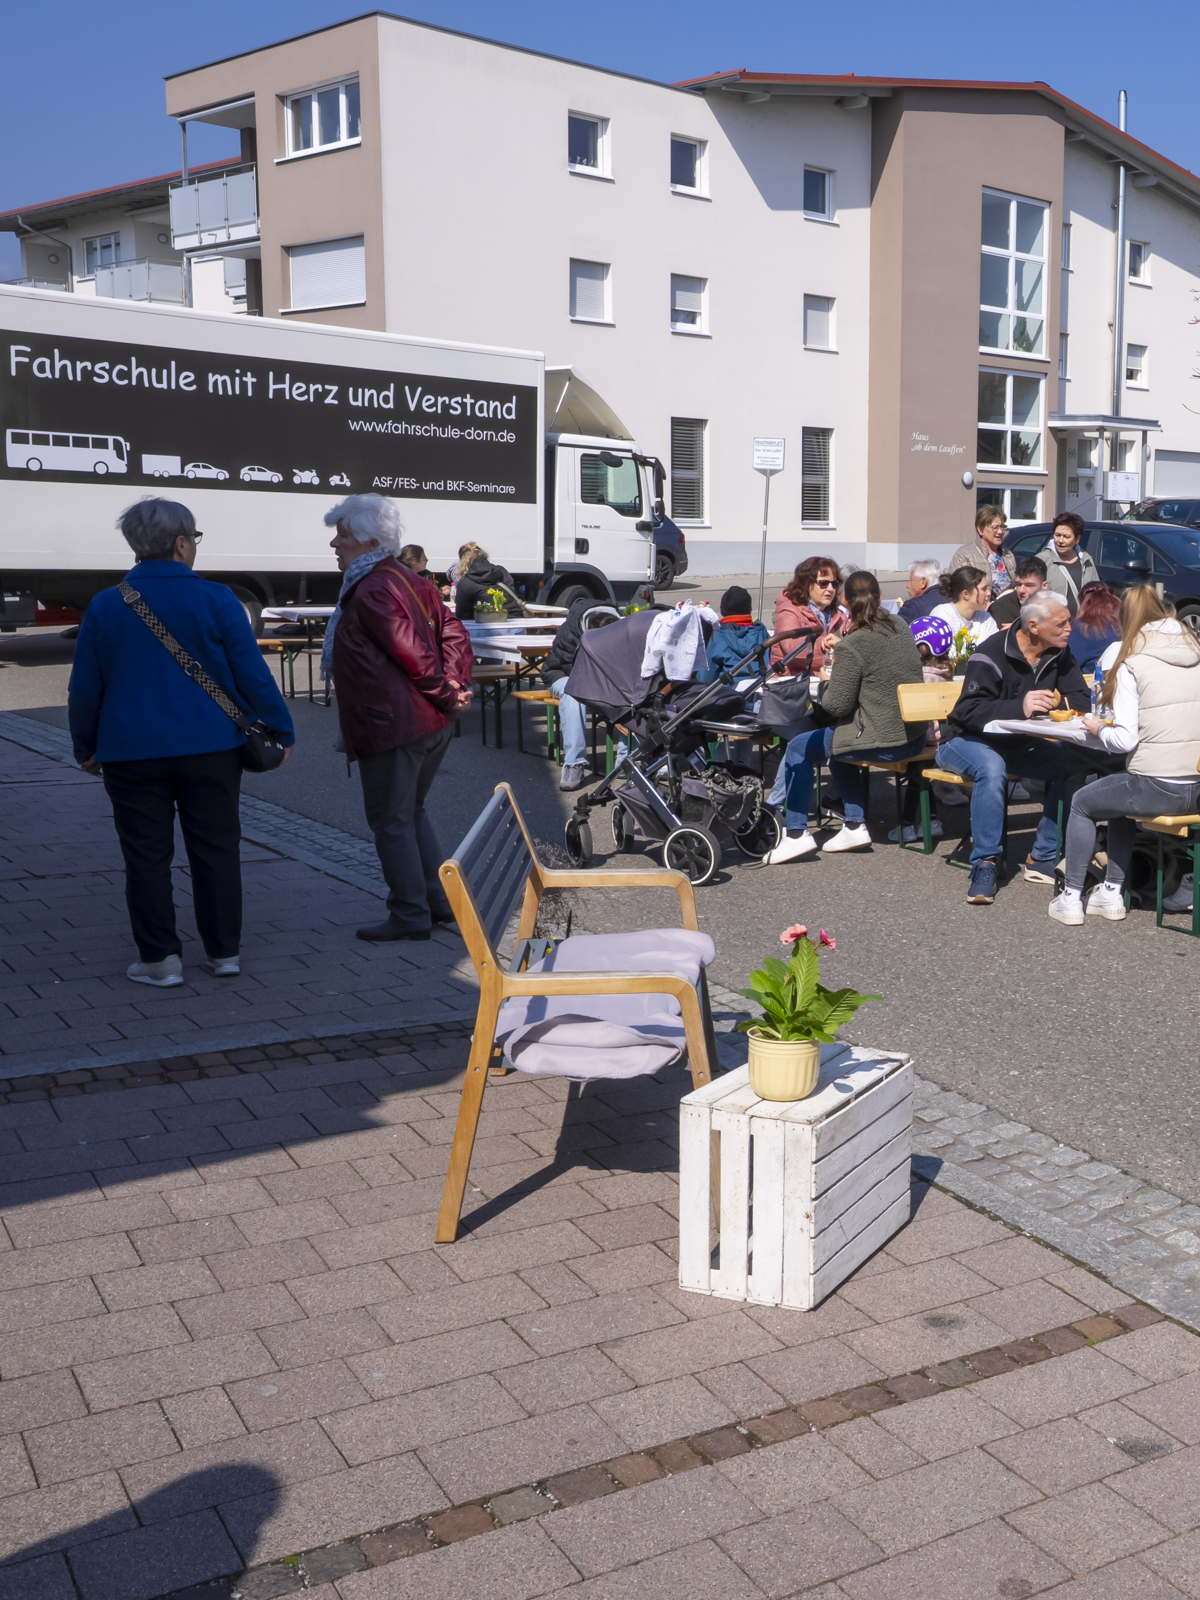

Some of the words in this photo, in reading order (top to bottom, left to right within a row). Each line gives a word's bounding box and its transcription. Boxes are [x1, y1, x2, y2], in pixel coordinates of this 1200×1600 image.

[10, 344, 197, 391] Fahrschule
[207, 368, 257, 397] mit
[268, 371, 339, 404] Herz
[348, 383, 394, 409] und
[404, 385, 516, 420] Verstand
[348, 419, 516, 443] www.fahrschule-dorn.de
[911, 431, 930, 441] Haus
[923, 443, 938, 452] dem
[372, 476, 420, 490] ASF/FES-
[422, 480, 444, 491] und
[446, 480, 516, 494] BKF-Seminare
